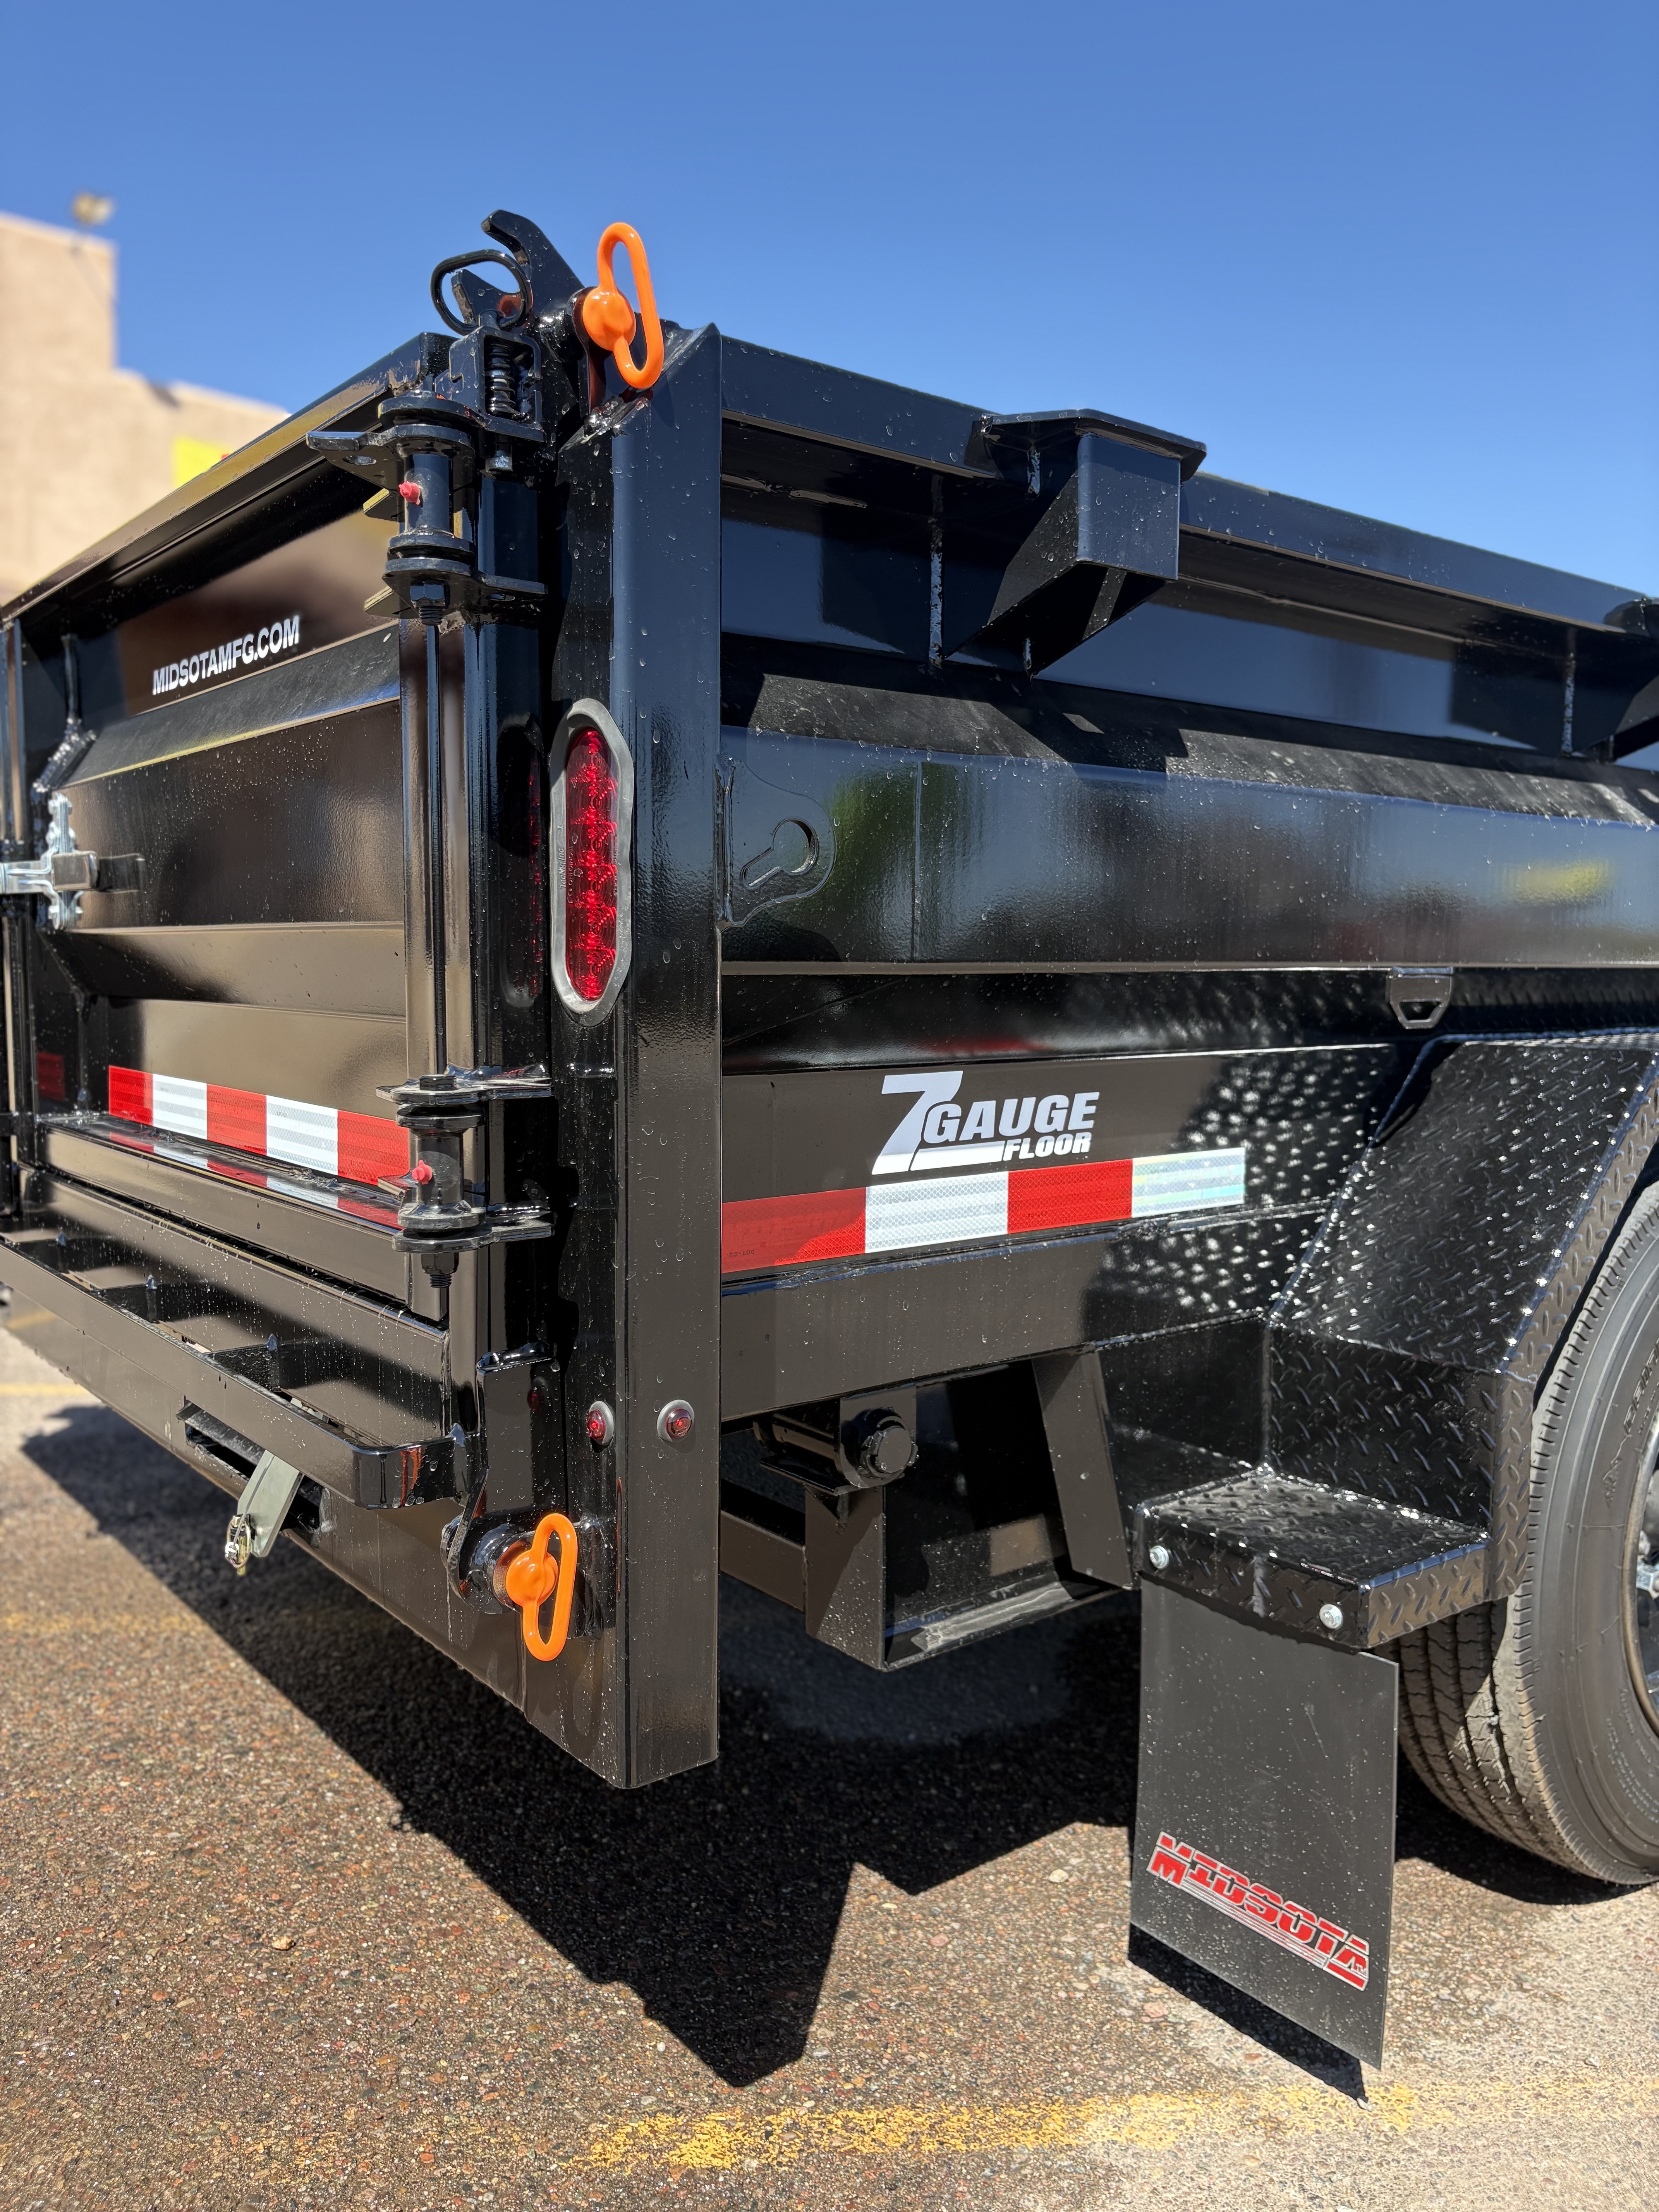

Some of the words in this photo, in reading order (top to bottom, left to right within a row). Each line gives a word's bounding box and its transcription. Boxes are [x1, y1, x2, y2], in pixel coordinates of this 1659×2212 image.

[153, 615, 300, 695] MIDSOTAMFG.COM
[872, 1070, 963, 1175] 7
[923, 1091, 1100, 1144] GAUGE
[1003, 1132, 1092, 1161] FLOOR
[1146, 1831, 1369, 1991] MIDSOTA
